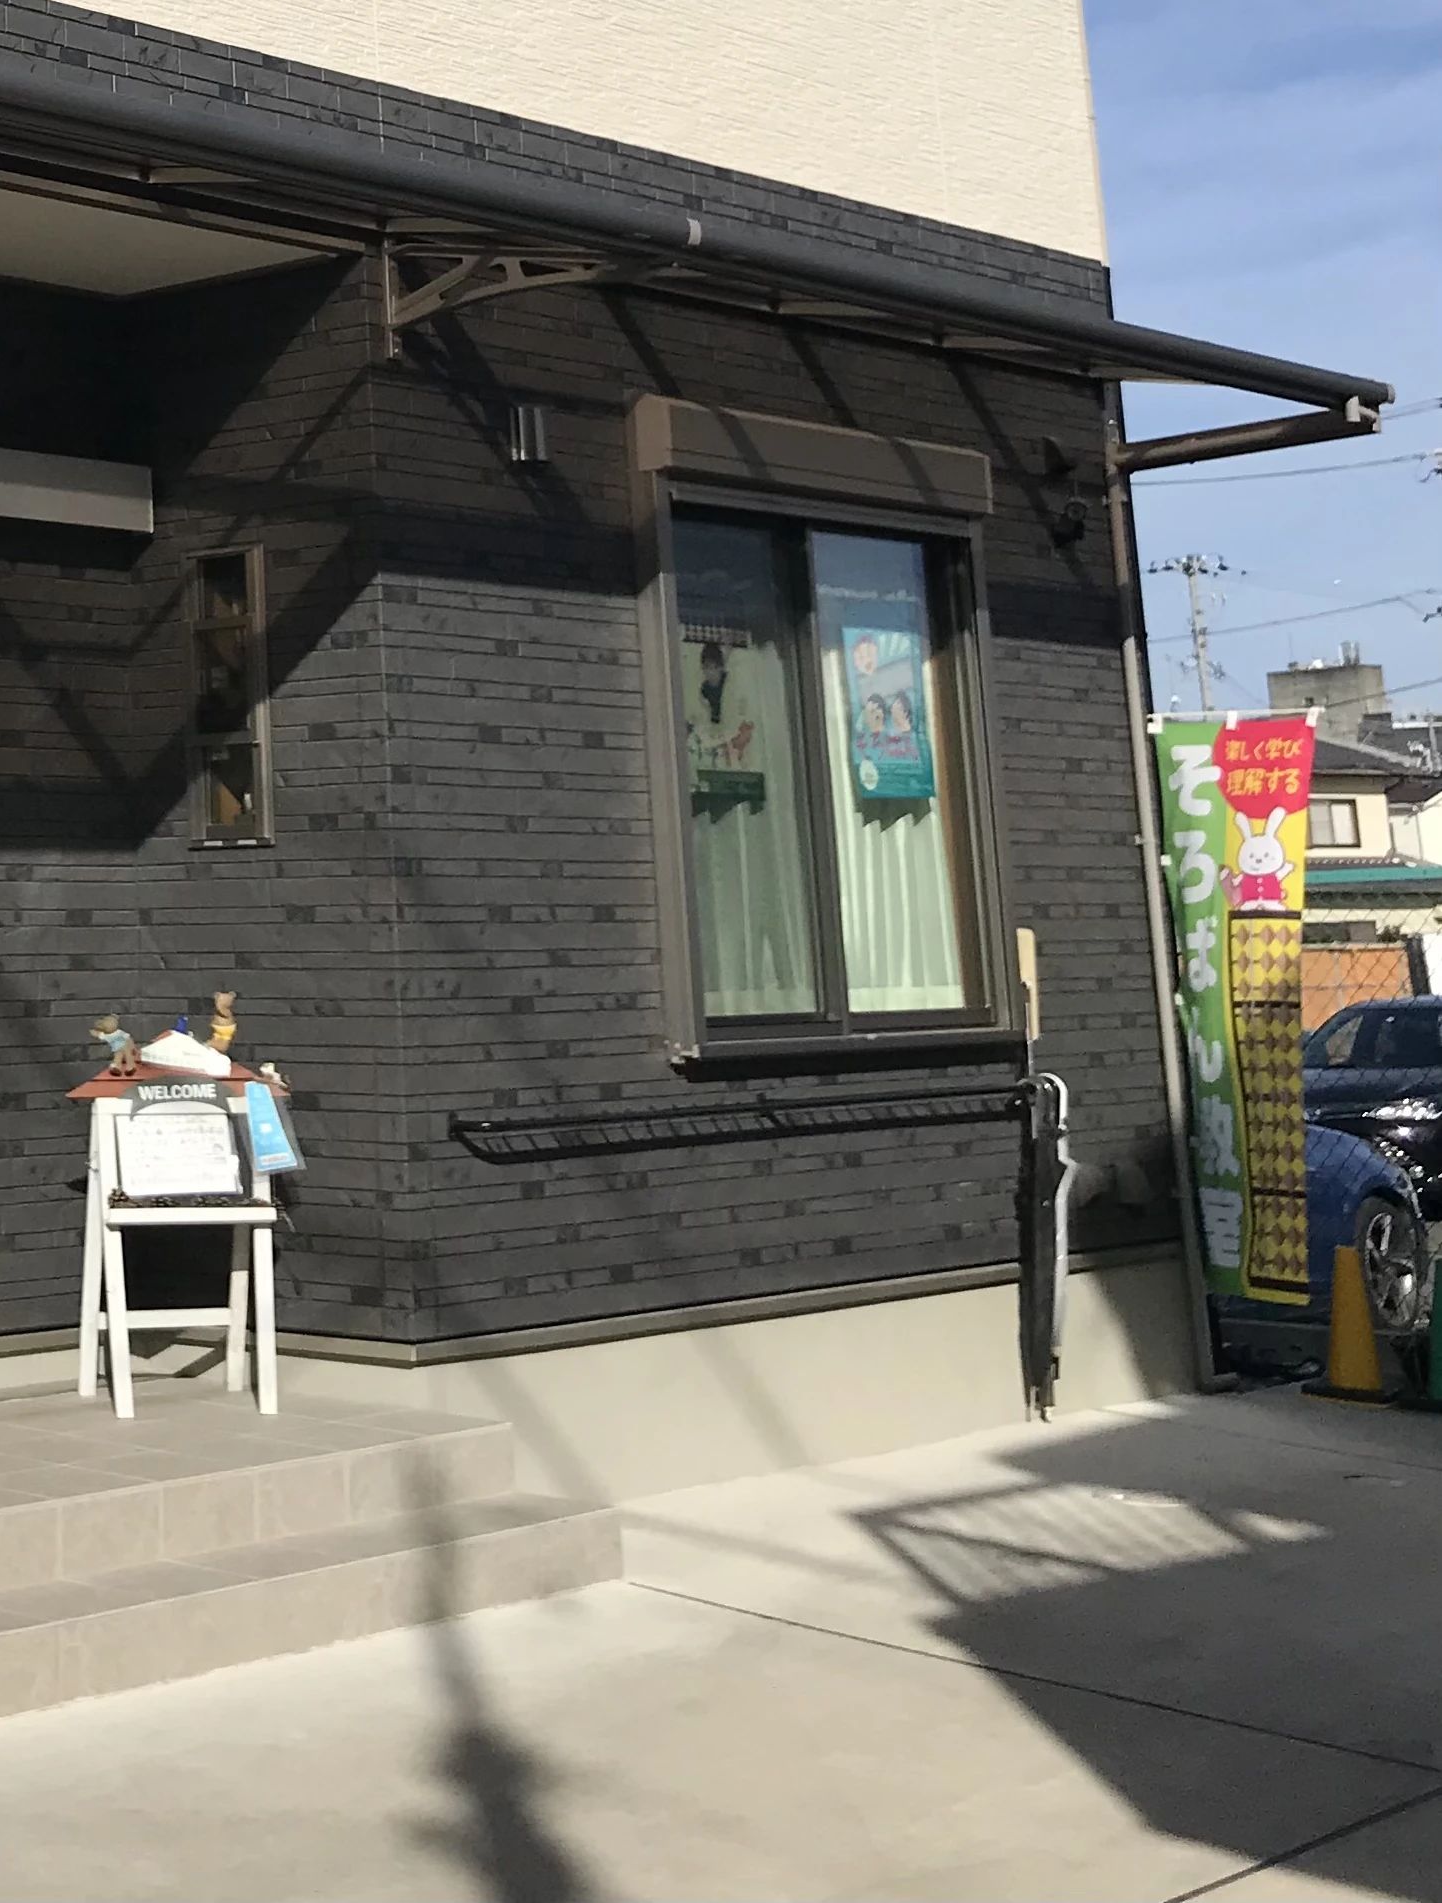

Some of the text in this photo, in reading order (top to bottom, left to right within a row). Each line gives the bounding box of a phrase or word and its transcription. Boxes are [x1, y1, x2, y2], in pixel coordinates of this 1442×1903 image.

[1225, 737, 1305, 763] 楽しく学び
[1226, 766, 1301, 796] 理解する
[138, 1083, 218, 1101] WELCOME
